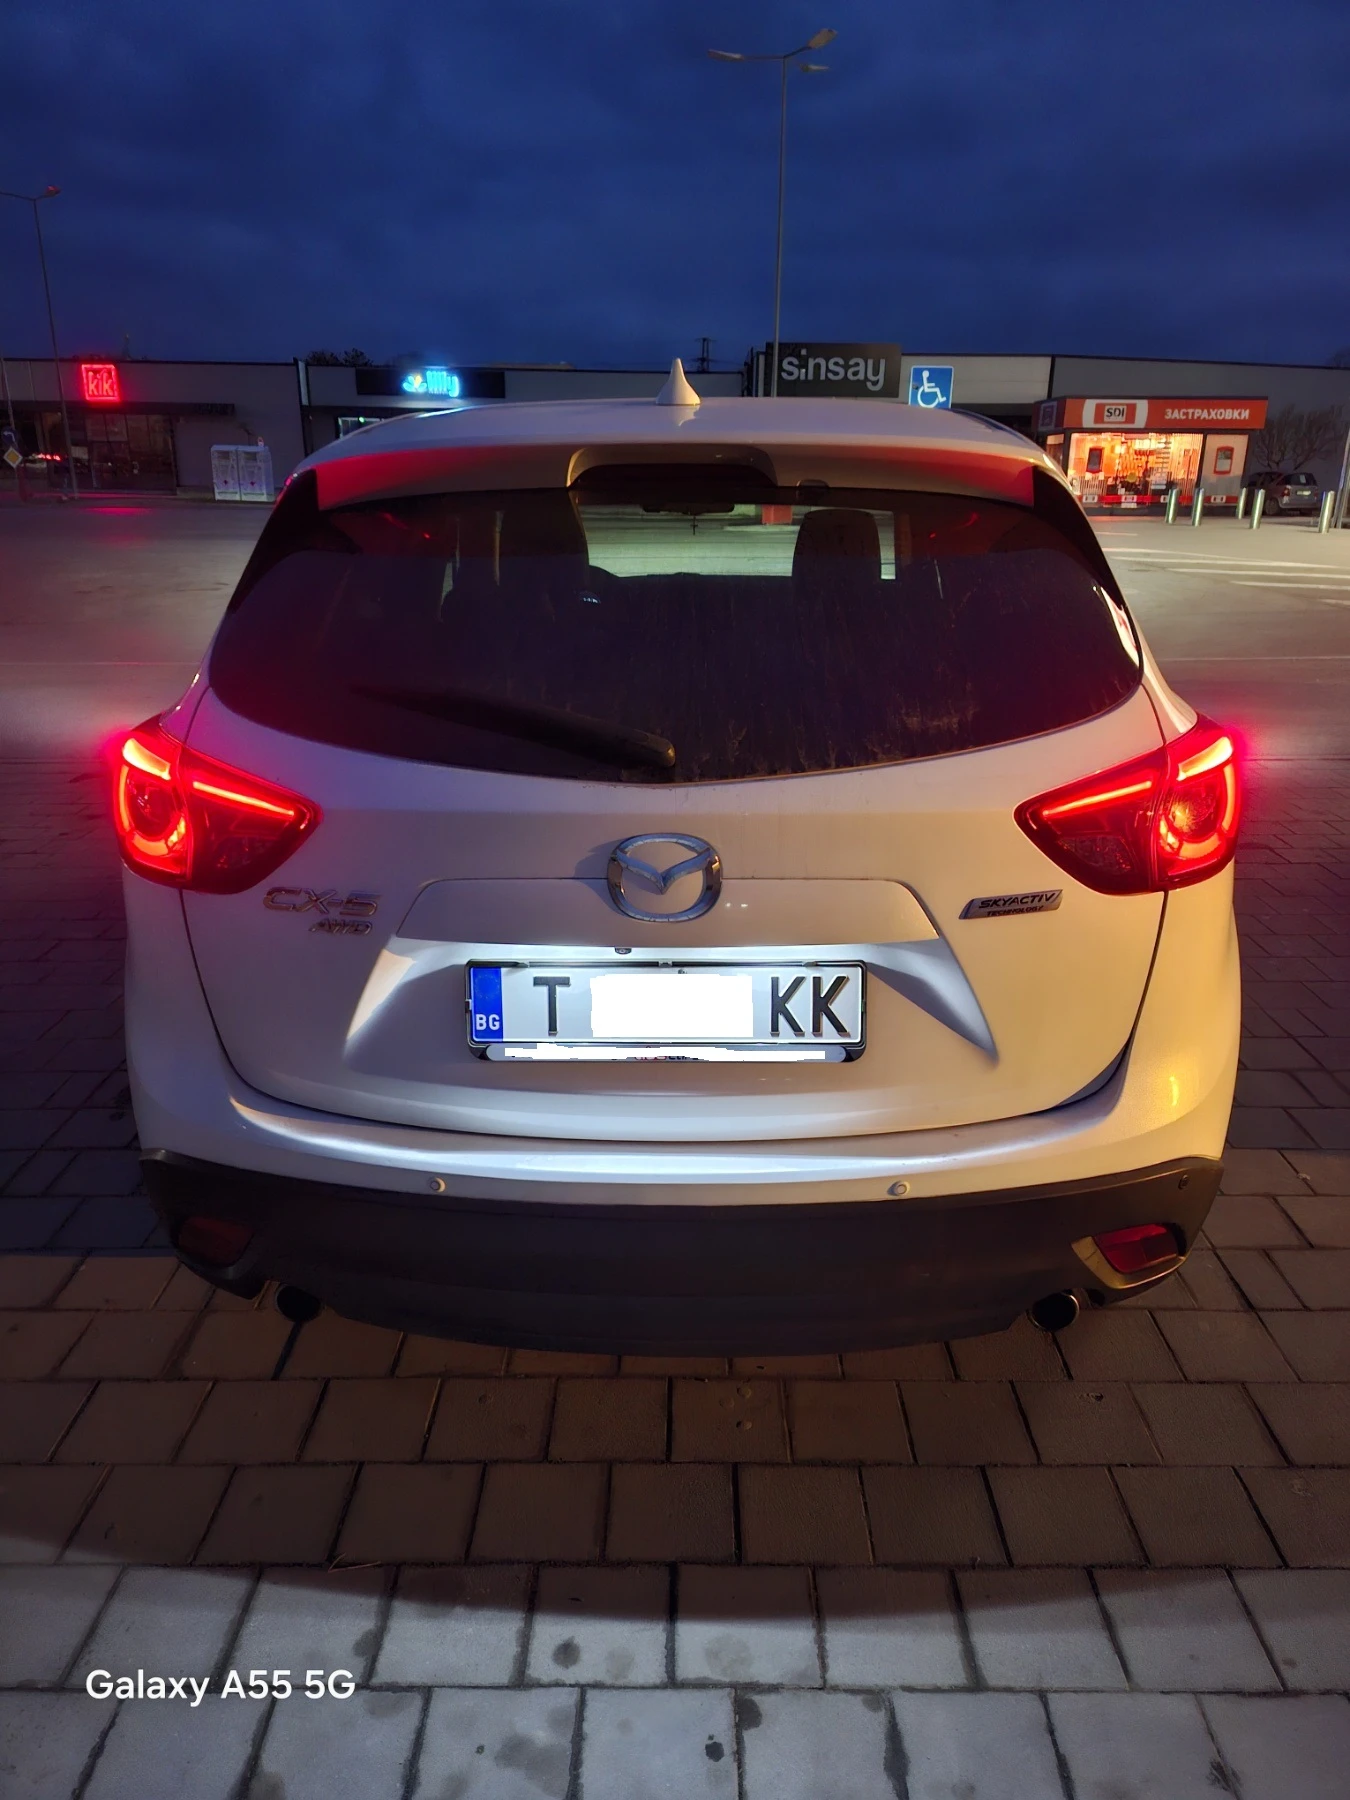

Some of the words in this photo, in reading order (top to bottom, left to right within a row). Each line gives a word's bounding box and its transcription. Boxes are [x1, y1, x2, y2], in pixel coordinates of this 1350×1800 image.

[781, 348, 886, 391] sinsay
[1105, 406, 1125, 418] SDI
[1164, 408, 1250, 420] ЗАСТРАХОВКИ
[262, 886, 381, 917] CX-5
[979, 892, 1056, 909] SKYACTIV
[986, 905, 1044, 917] TECHNOLOGY
[308, 919, 372, 934] AWD
[532, 976, 571, 1036] T
[770, 976, 850, 1037] KK
[475, 1013, 500, 1031] BG
